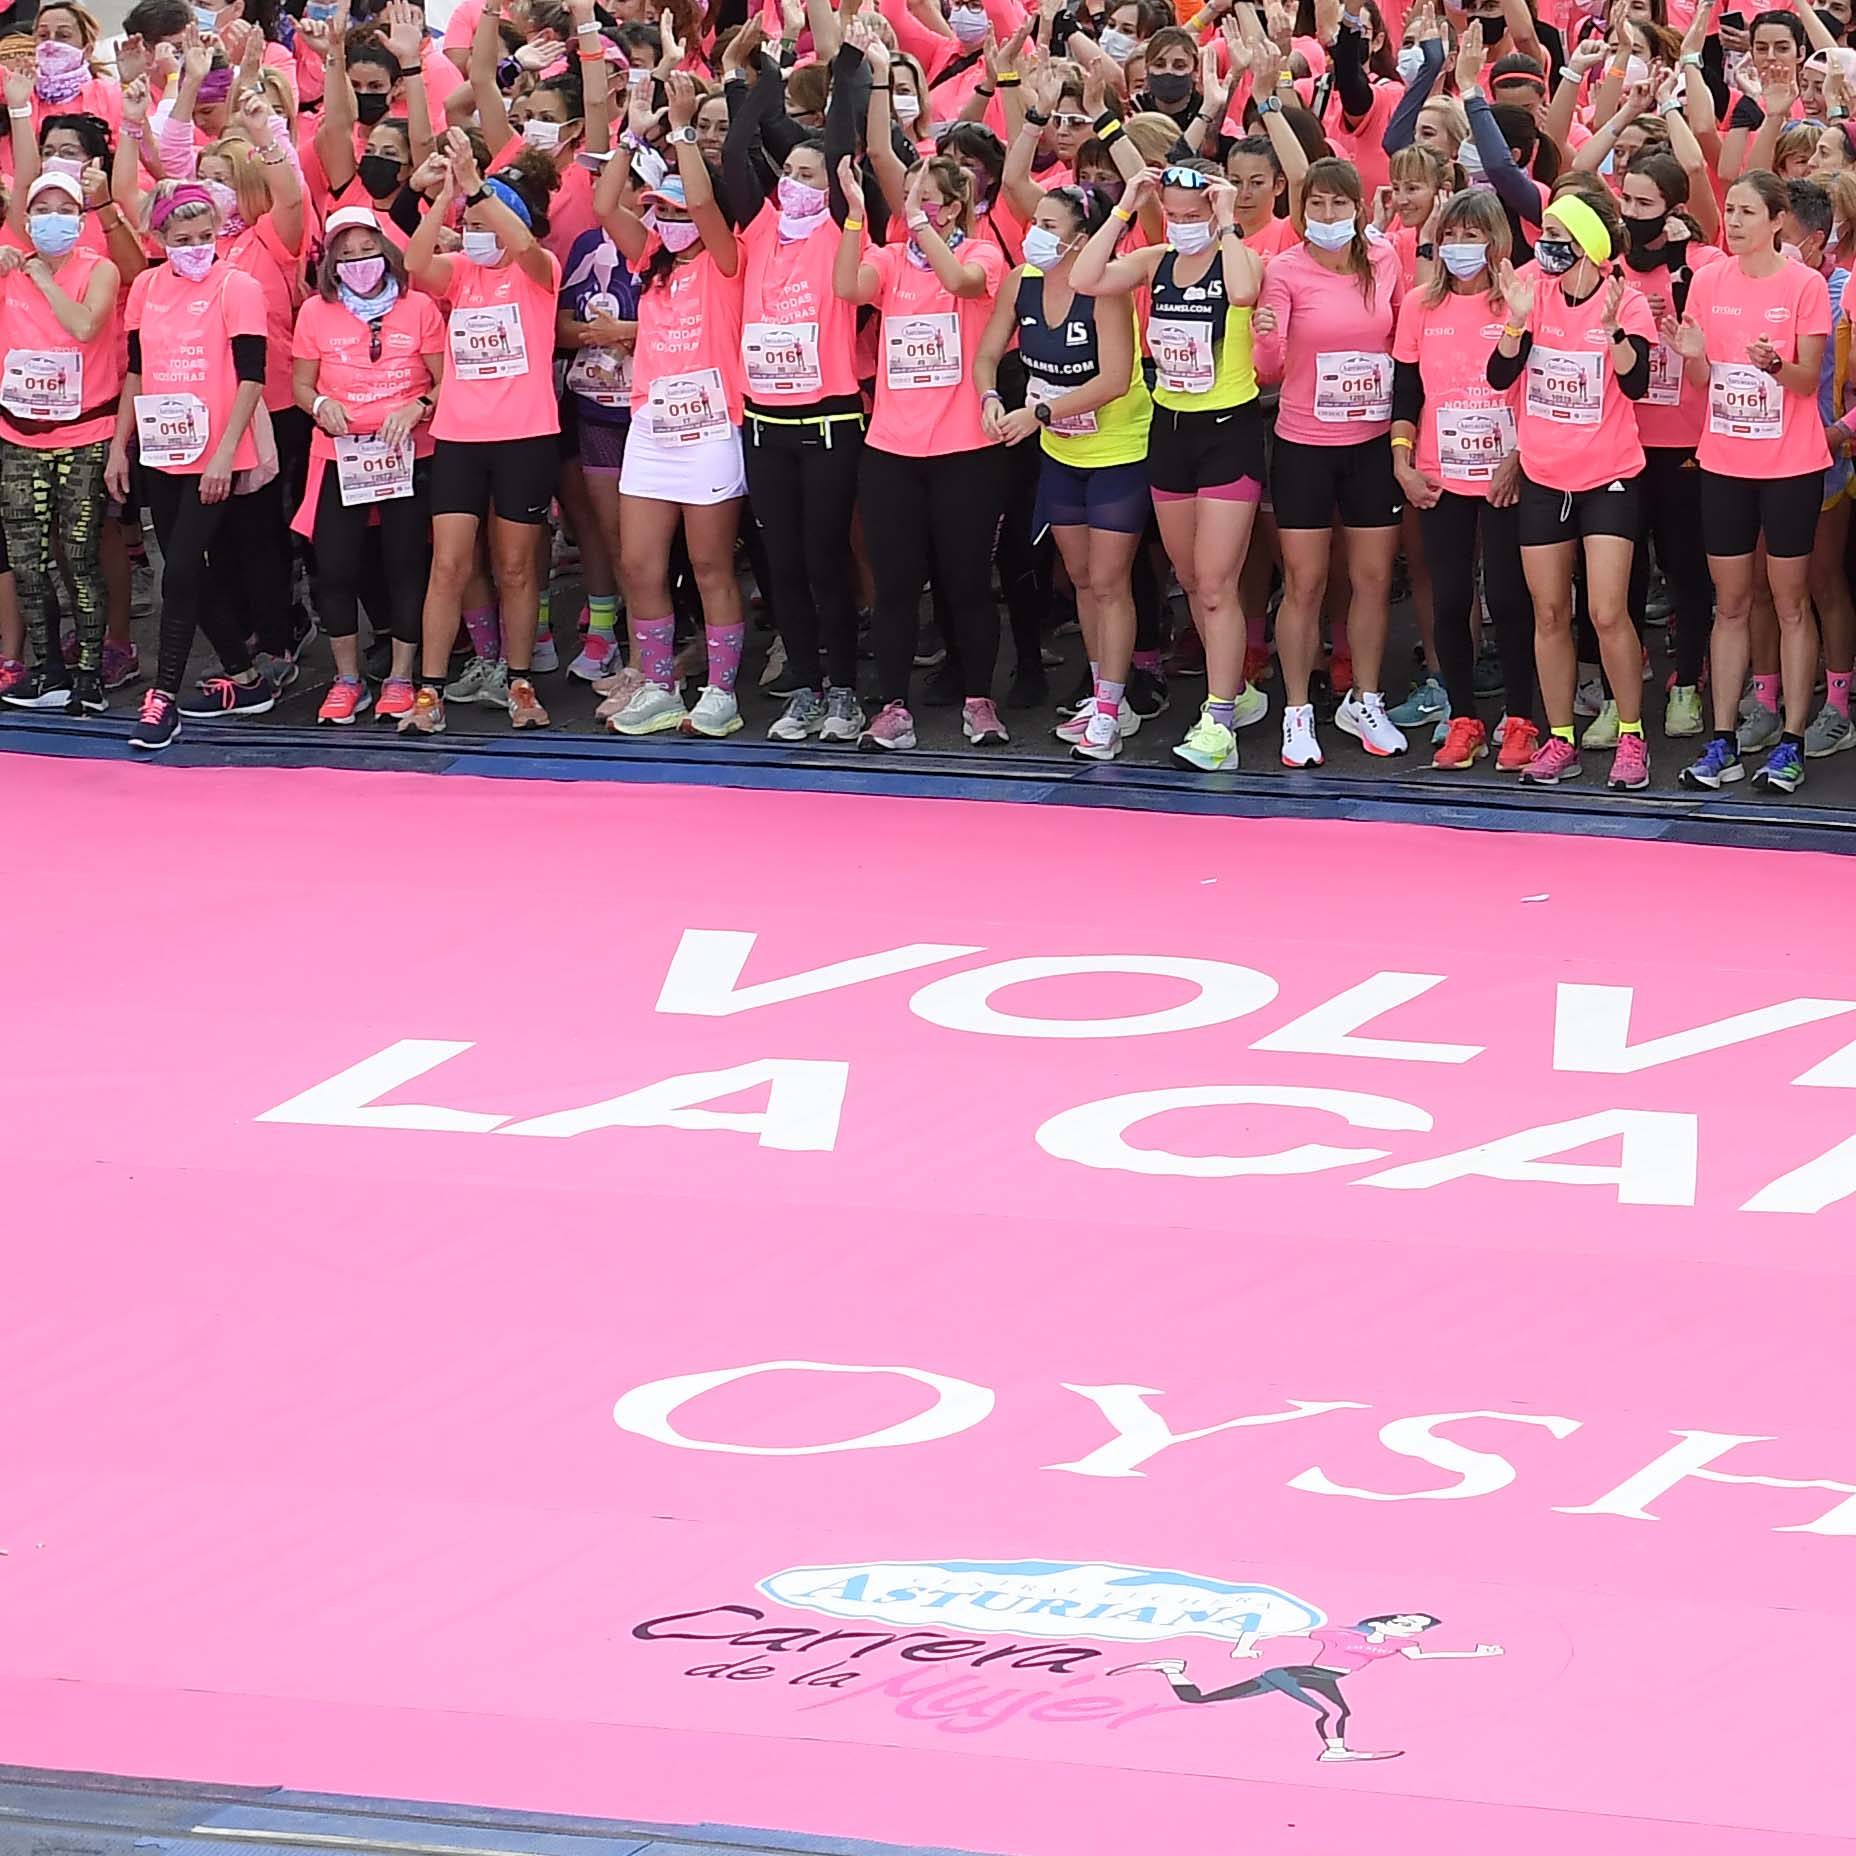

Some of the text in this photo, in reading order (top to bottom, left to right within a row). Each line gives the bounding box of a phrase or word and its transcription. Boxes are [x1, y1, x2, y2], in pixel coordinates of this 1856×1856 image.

[783, 281, 809, 295] POR
[1155, 303, 1214, 315] LASANSI.COM
[470, 334, 499, 350] 016
[1065, 321, 1089, 347] LS
[766, 350, 797, 366] 016
[907, 343, 936, 358] 016
[1164, 348, 1190, 362] 016
[25, 376, 58, 392] 016
[1342, 379, 1374, 394] 016
[1546, 377, 1579, 394] 016
[1726, 392, 1758, 408] 016
[667, 401, 702, 418] 016
[159, 421, 188, 437] 016
[1461, 435, 1493, 451] 016
[363, 456, 397, 474] 016
[250, 1038, 851, 1154] LA
[800, 1573, 1268, 1637] ASTURIANA
[631, 1604, 1103, 1676] Carrera
[684, 1655, 1219, 1734] de la Mujer
